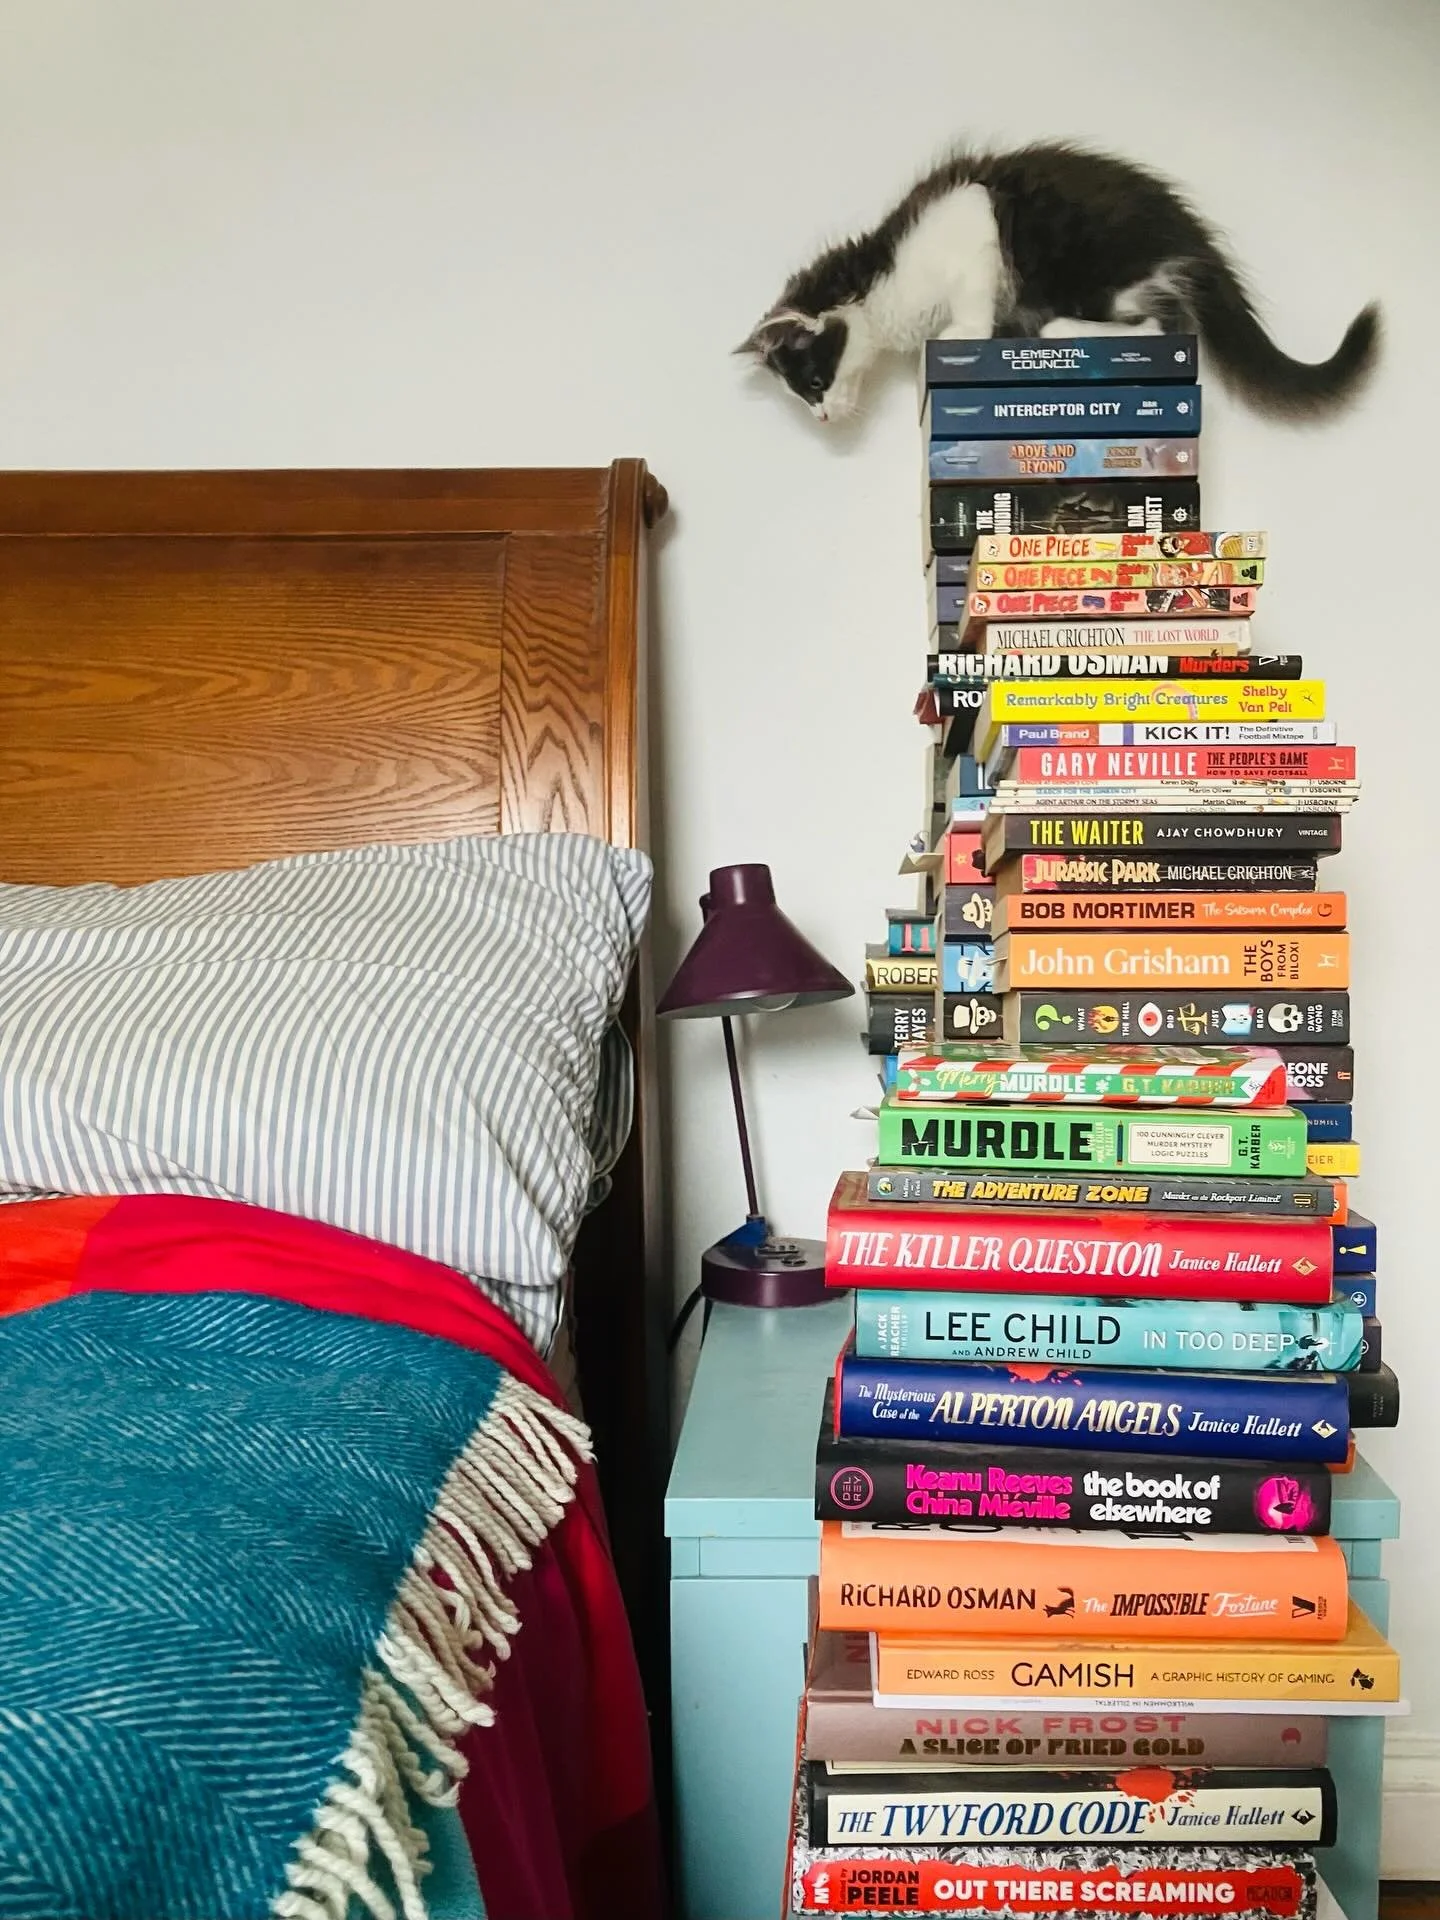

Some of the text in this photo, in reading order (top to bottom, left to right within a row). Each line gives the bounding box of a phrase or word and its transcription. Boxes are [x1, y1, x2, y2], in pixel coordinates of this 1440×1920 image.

[1001, 348, 1091, 360] ELEMENTAL
[1012, 359, 1081, 370] COUNCIL
[994, 403, 1085, 417] INTERCEPTOR
[1090, 402, 1121, 416] CITY
[1009, 443, 1076, 459] ABOVE AND
[1019, 459, 1066, 474] BEYOND
[976, 510, 993, 530] THE
[1127, 505, 1145, 527] DAN
[1009, 535, 1091, 558] ONE PIECE
[997, 627, 1219, 649] MICHAEL CRICHTON THE LOST WORLD
[1067, 655, 1249, 675] OSMAN Murders
[1006, 692, 1229, 711] Remarkably Bright Creatures
[1242, 685, 1288, 700] Shelby
[1239, 701, 1292, 713] Van Pelt
[1019, 726, 1230, 740] Paul Brand KICK IT!
[1273, 733, 1305, 742] Mixtape
[1207, 752, 1308, 766] THE PEOPLE'S GAME
[1030, 820, 1328, 846] THE WAITER AJAY CHOWDHURY VINTAGE
[1031, 857, 1292, 885] JURASSIC PARK MICHAEL CRICHTON
[1202, 902, 1313, 919] The Satsuma Complex
[1020, 945, 1230, 976] John Grisham
[1243, 944, 1257, 977] THE
[1260, 939, 1274, 982] BOYS
[1277, 943, 1287, 978] FROM
[1290, 941, 1300, 980] BILOXI
[894, 1007, 909, 1048] TERRY
[1077, 1007, 1085, 1031] WHAT
[1122, 1001, 1130, 1037] THE HELL
[1166, 1016, 1175, 1029] DID
[1211, 1009, 1219, 1028] JUST
[1256, 1008, 1264, 1029] READ
[1307, 1005, 1315, 1032] DAVID
[1287, 1062, 1329, 1075] EONE
[936, 1068, 1156, 1096] Merry MURDLE G.T.
[901, 1118, 1093, 1162] MURDLE
[1180, 1141, 1212, 1149] MYSTERY
[1197, 1132, 1225, 1140] CLEVER
[1238, 1136, 1248, 1156] G.T.
[1250, 1124, 1261, 1169] KARBER
[933, 1180, 967, 1199] THE
[971, 1181, 1081, 1201] ADVENTURE
[1085, 1184, 1150, 1202] ZONE
[1162, 1191, 1191, 1201] Murder
[1210, 1192, 1246, 1205] Rockport
[837, 1231, 1282, 1278] THE KILLER QUESTION Janice Hallett
[878, 1313, 887, 1342] JACK
[890, 1304, 900, 1357] REACHER
[925, 1311, 1120, 1345] LEE CHILD
[974, 1346, 1040, 1357] ANDREW
[1045, 1348, 1092, 1359] CHILD
[858, 1382, 936, 1406] The Mysterious
[872, 1401, 898, 1419] Case
[929, 1391, 1183, 1437] ALPERTON ANGELS
[843, 1477, 852, 1501] DEL
[853, 1475, 862, 1502] REY
[906, 1463, 1073, 1495] Keanu Reeves
[1083, 1470, 1221, 1500] the book of
[906, 1490, 1071, 1520] China Miéville
[1089, 1499, 1212, 1525] elsewhere
[947, 1586, 1036, 1610] OSMAN
[1082, 1597, 1108, 1614] The
[1211, 1592, 1279, 1617] Fortune
[907, 1661, 1335, 1689] EDWARD ROSS GAMISH A GRAPHIC HISTORY OF GAMING
[915, 1714, 1186, 1736] NICK FROST
[900, 1738, 1206, 1756] A SLICE OF FRIED GOLD
[837, 1799, 1150, 1838] THE TWYFORD CODE
[933, 1878, 1235, 1904] OUT THERE SCREAMING
